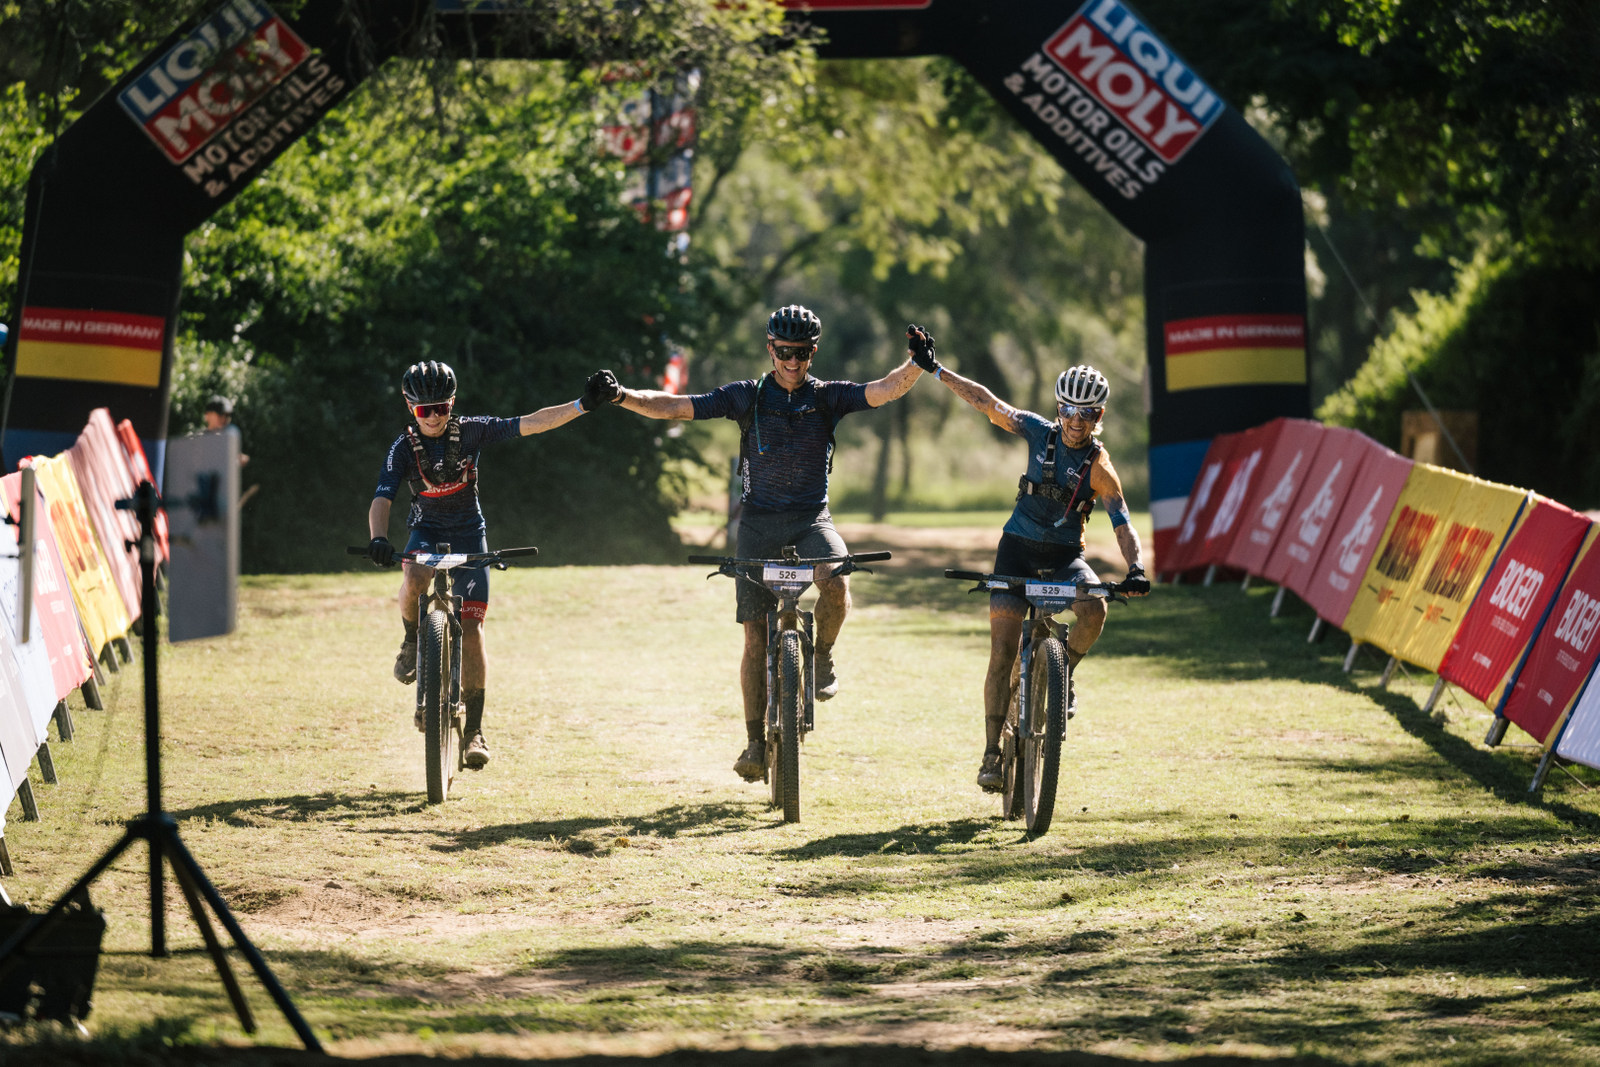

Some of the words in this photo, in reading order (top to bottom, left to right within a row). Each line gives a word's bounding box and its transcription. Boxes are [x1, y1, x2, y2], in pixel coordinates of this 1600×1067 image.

[1021, 52, 1110, 137] MOTOR
[1103, 128, 1166, 184] OILS
[1055, 23, 1198, 148] MOLY
[1090, 0, 1216, 118] LIQUI
[204, 178, 228, 198] &
[228, 73, 345, 183] ADDITIVES
[1003, 73, 1026, 94] &
[1021, 93, 1143, 199] ADDITIVES
[22, 317, 62, 331] MADE
[64, 319, 81, 333] IN
[83, 320, 162, 340] GERMANY
[1168, 327, 1214, 344] MADE
[1216, 325, 1235, 339] IN
[779, 571, 797, 580] 526
[1042, 586, 1060, 596] 525
